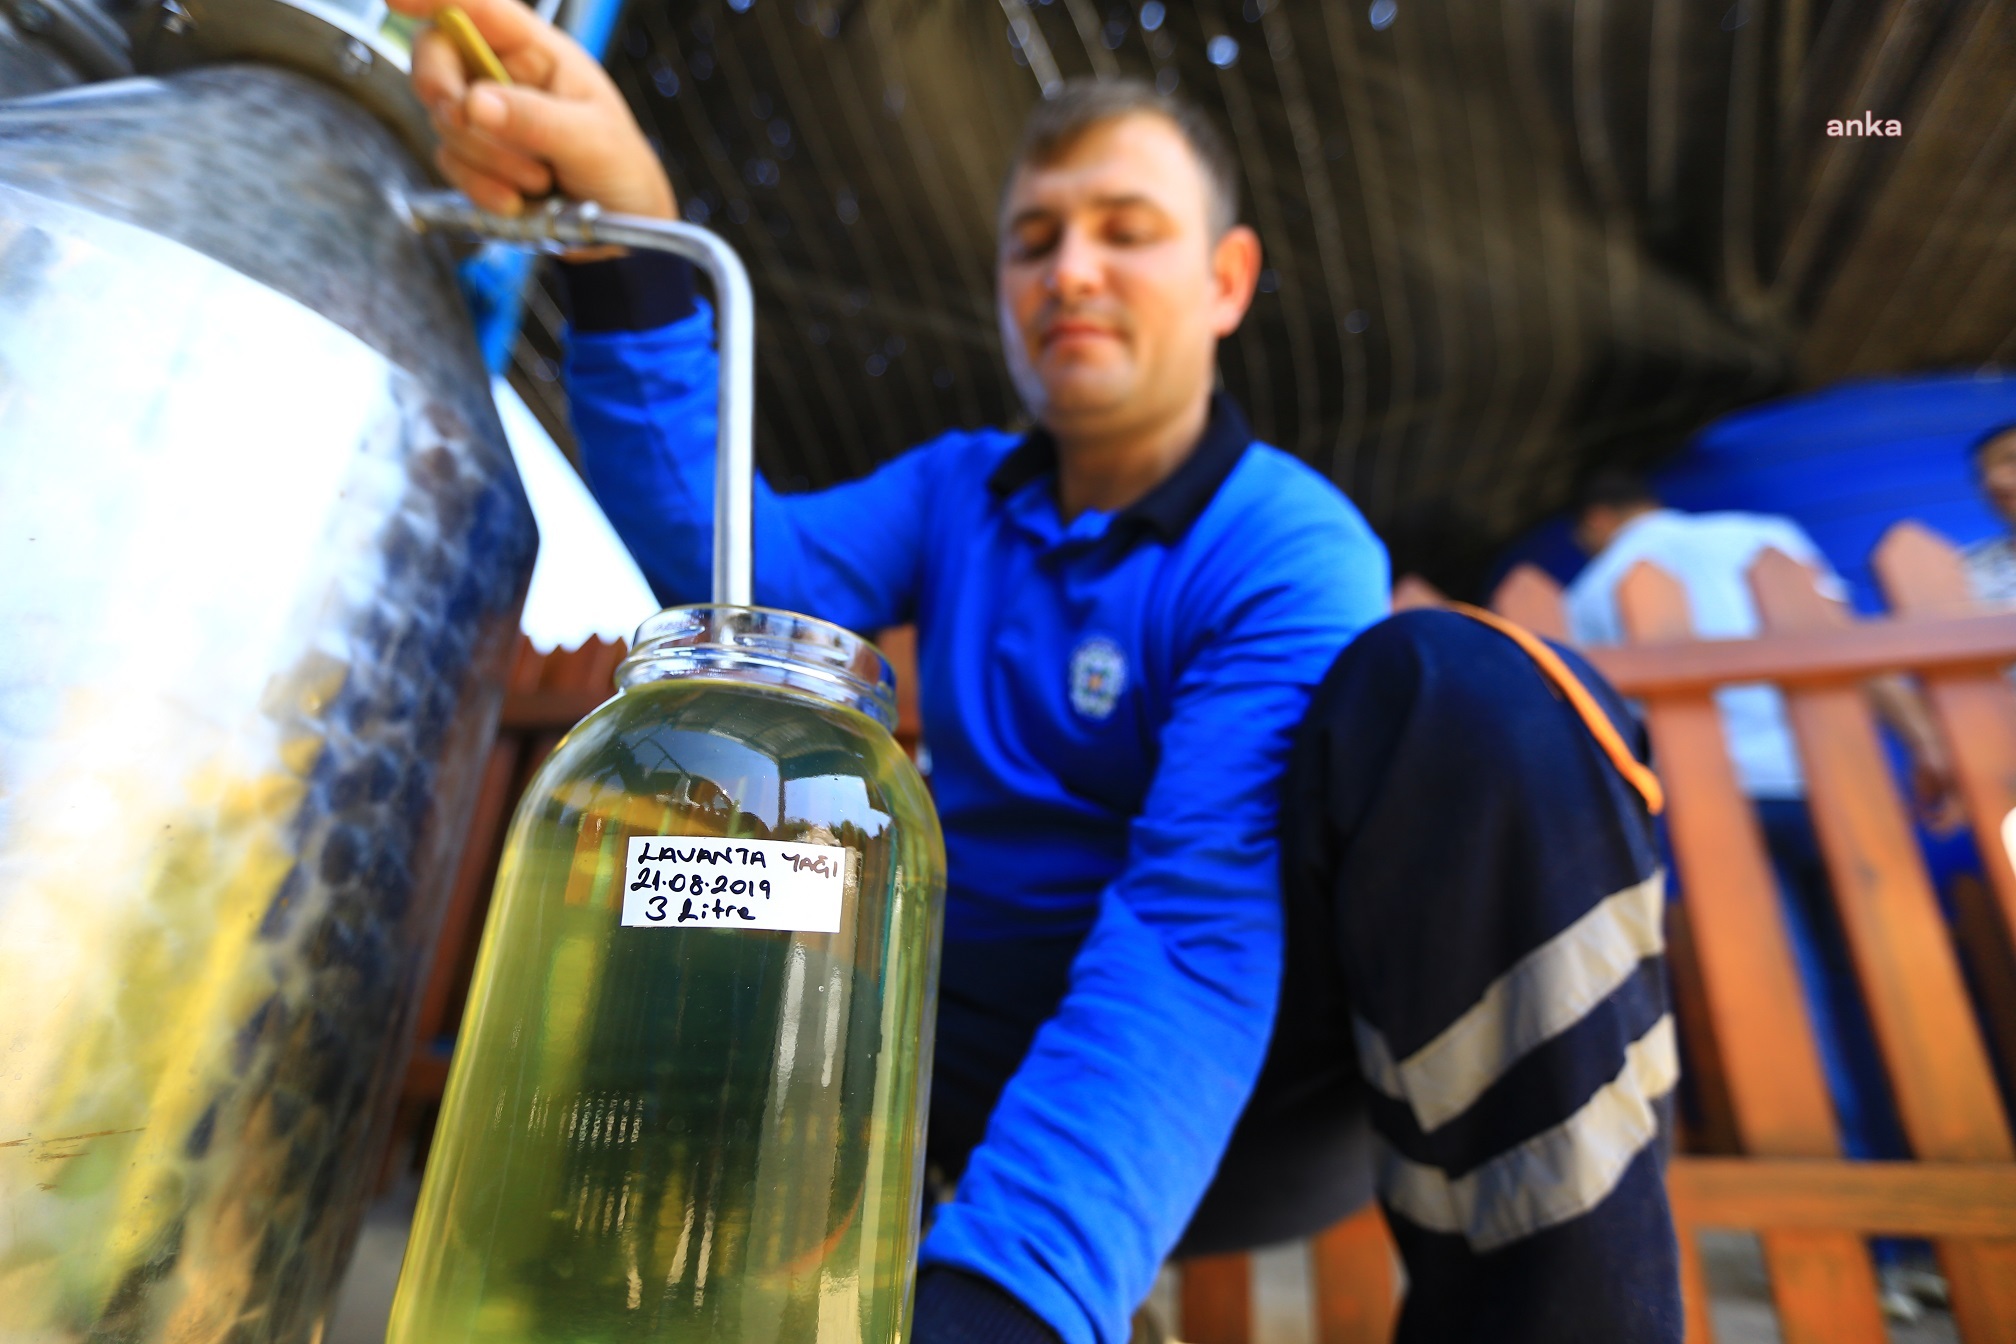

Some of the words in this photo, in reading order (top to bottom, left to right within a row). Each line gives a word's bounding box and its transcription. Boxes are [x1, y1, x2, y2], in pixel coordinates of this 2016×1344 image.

[638, 843, 767, 868] LAVANTA
[630, 867, 771, 900] 21.08.2019
[645, 896, 668, 921] 3
[678, 898, 756, 923] Litre
